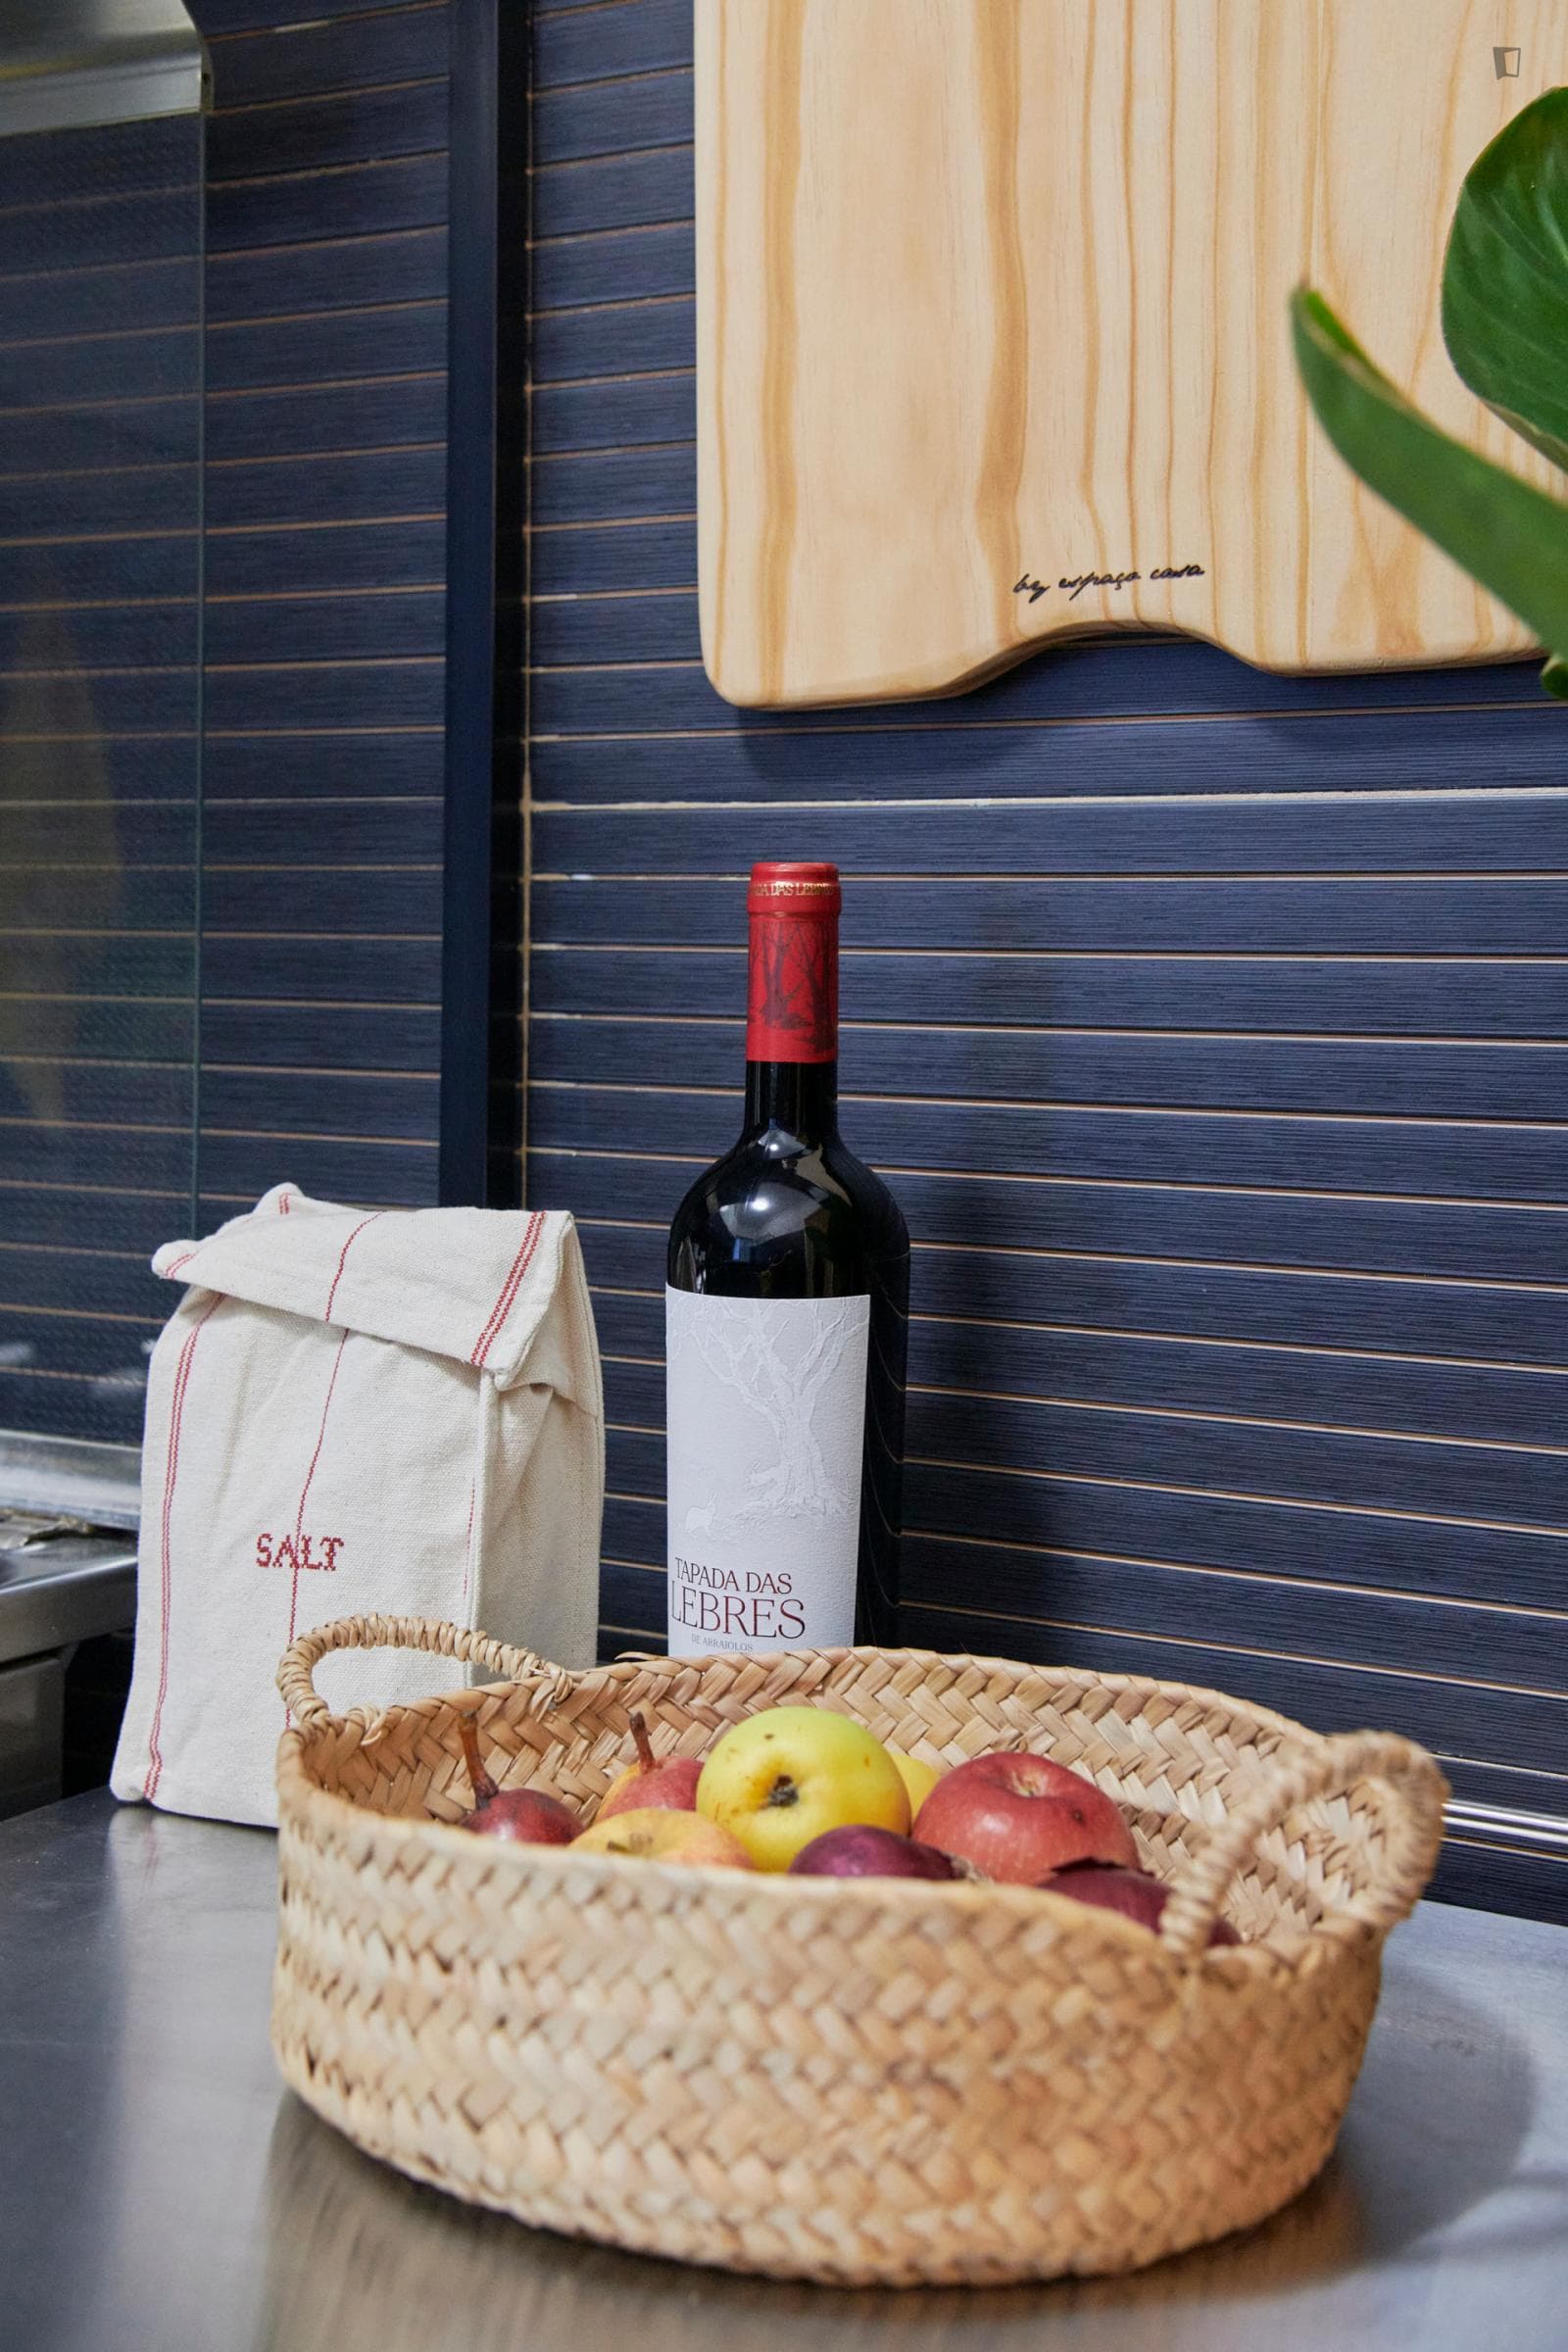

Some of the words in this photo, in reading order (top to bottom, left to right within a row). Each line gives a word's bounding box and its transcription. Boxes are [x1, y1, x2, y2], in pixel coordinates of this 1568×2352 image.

[1012, 573, 1051, 604] by
[1058, 568, 1142, 601] espaço
[1149, 564, 1205, 580] casa
[256, 1533, 345, 1571] SALT
[674, 1556, 740, 1592] TAPADA
[745, 1571, 793, 1595] DAS
[671, 1580, 806, 1640] LEBRES
[691, 1634, 701, 1645] DE
